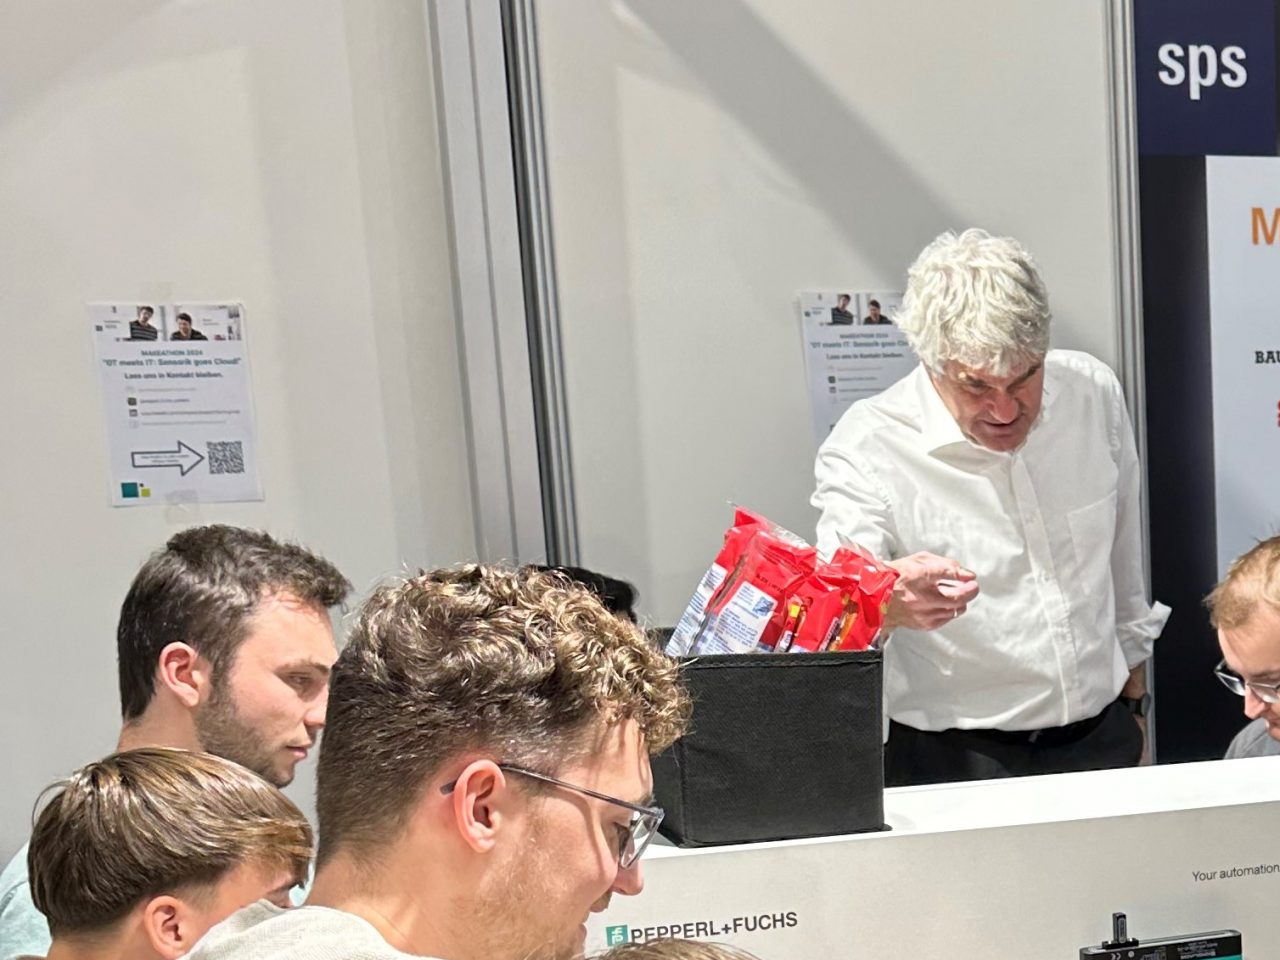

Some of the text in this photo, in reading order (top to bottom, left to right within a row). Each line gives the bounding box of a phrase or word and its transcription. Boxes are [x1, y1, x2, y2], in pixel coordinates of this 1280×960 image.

[1157, 43, 1248, 100] sps
[1192, 870, 1217, 882] Your
[630, 911, 798, 944] PEPPERL+FUCHS
